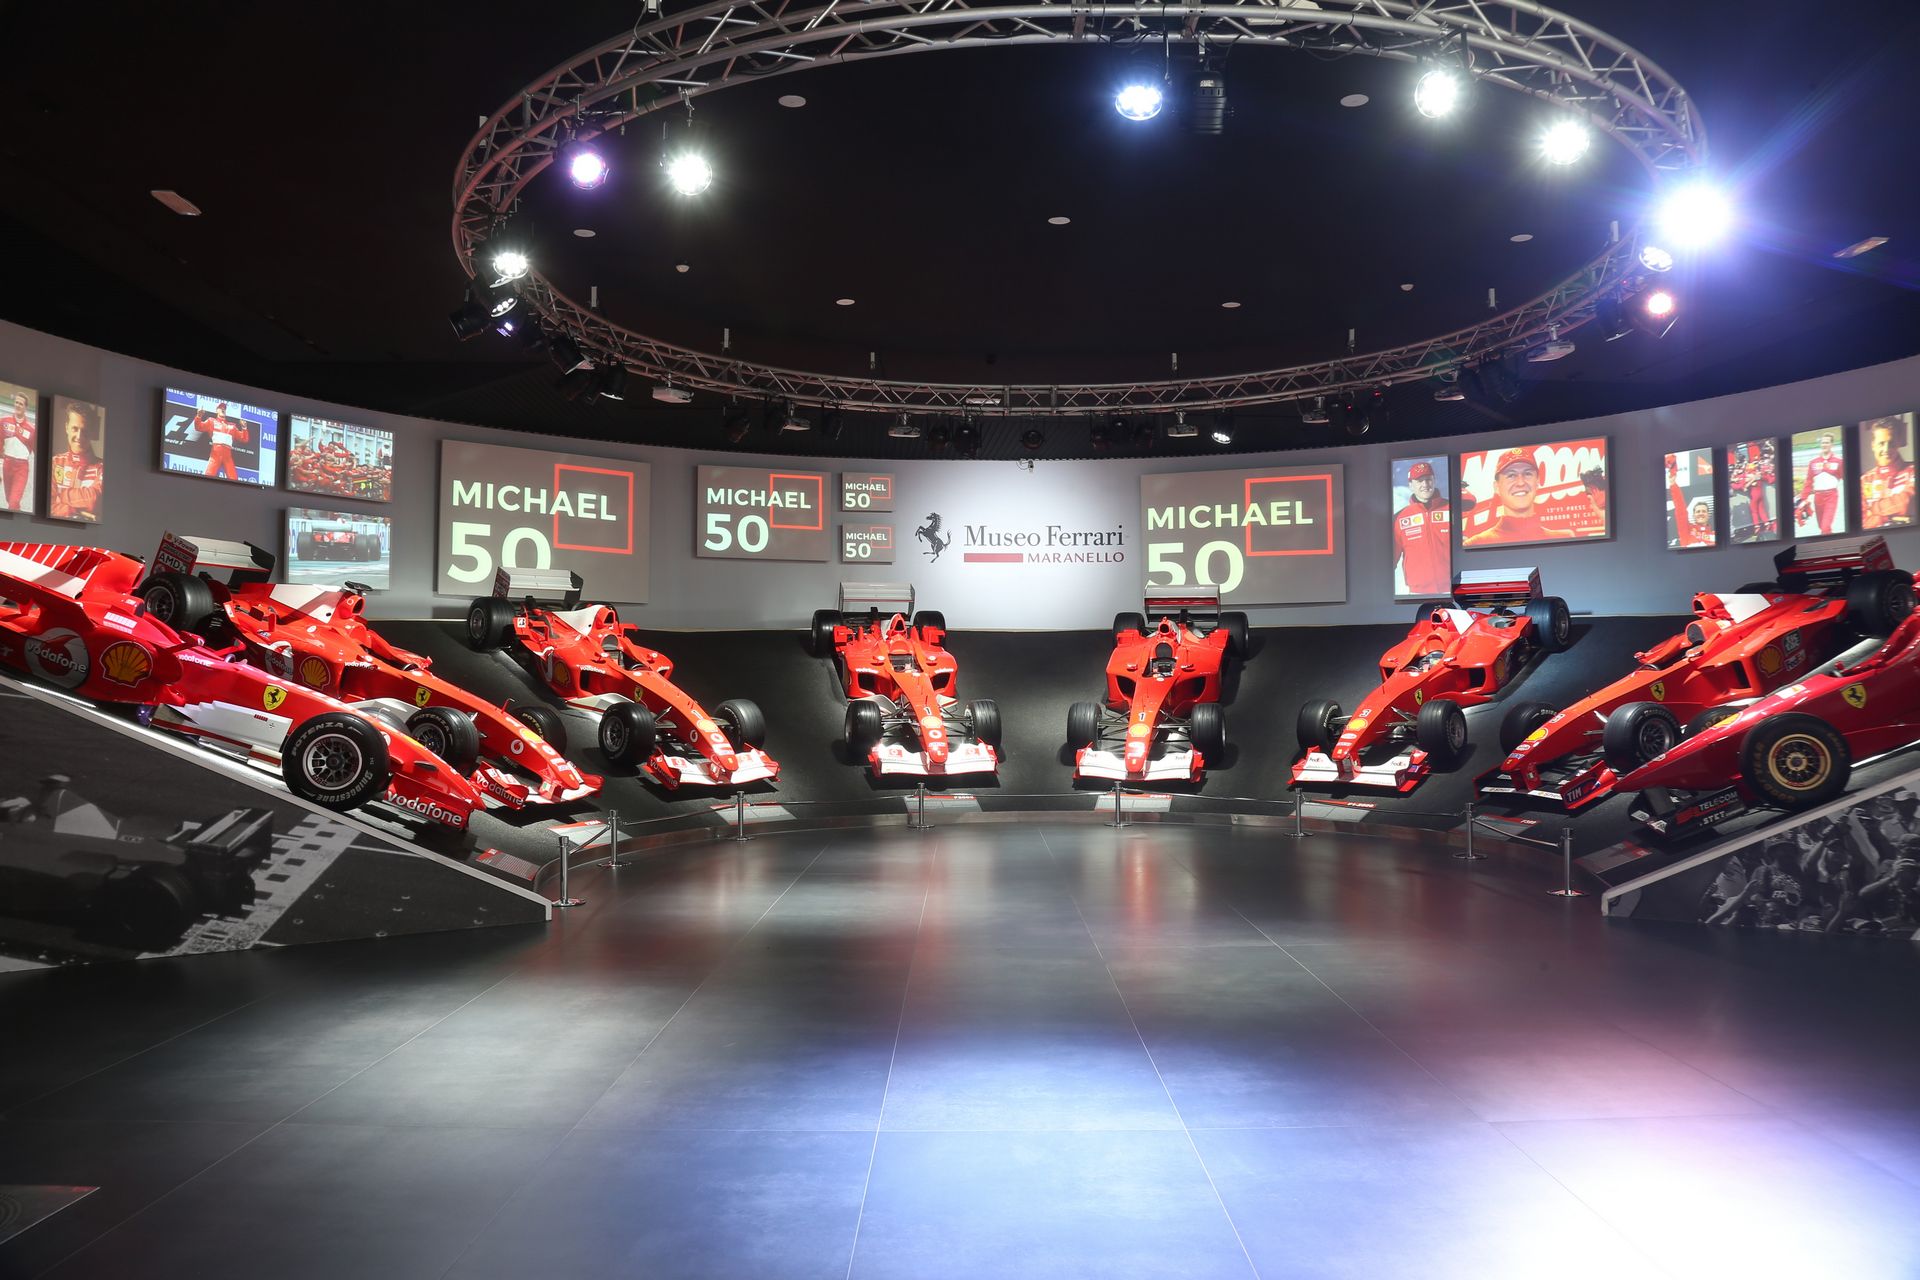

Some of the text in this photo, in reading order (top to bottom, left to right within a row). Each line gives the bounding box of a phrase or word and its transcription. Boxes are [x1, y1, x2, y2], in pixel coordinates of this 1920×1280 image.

[243, 404, 271, 418] Allianz
[846, 483, 887, 491] MICHAEL
[453, 480, 616, 520] MICHAEL
[708, 488, 812, 509] MICHAEL
[845, 493, 871, 508] 50
[1148, 501, 1314, 530] MICHAEL
[705, 513, 769, 552] 50
[846, 533, 888, 541] MICHAEL
[964, 525, 1124, 546] Museo Ferrari
[159, 552, 181, 569] AMD
[447, 522, 551, 583] 50
[845, 543, 872, 558] 50
[1027, 552, 1125, 563] MARANELLO
[1148, 541, 1244, 593] 50
[28, 640, 87, 673] vodafone
[1138, 712, 1146, 721] 1
[1359, 709, 1371, 717] 3
[291, 722, 344, 756] POTENZA
[317, 769, 374, 802] BRIDGESTONE
[476, 775, 524, 806] vodafone
[1566, 786, 1582, 802] TIM
[387, 790, 462, 826] vodafone
[1699, 791, 1738, 811] TELECOM
